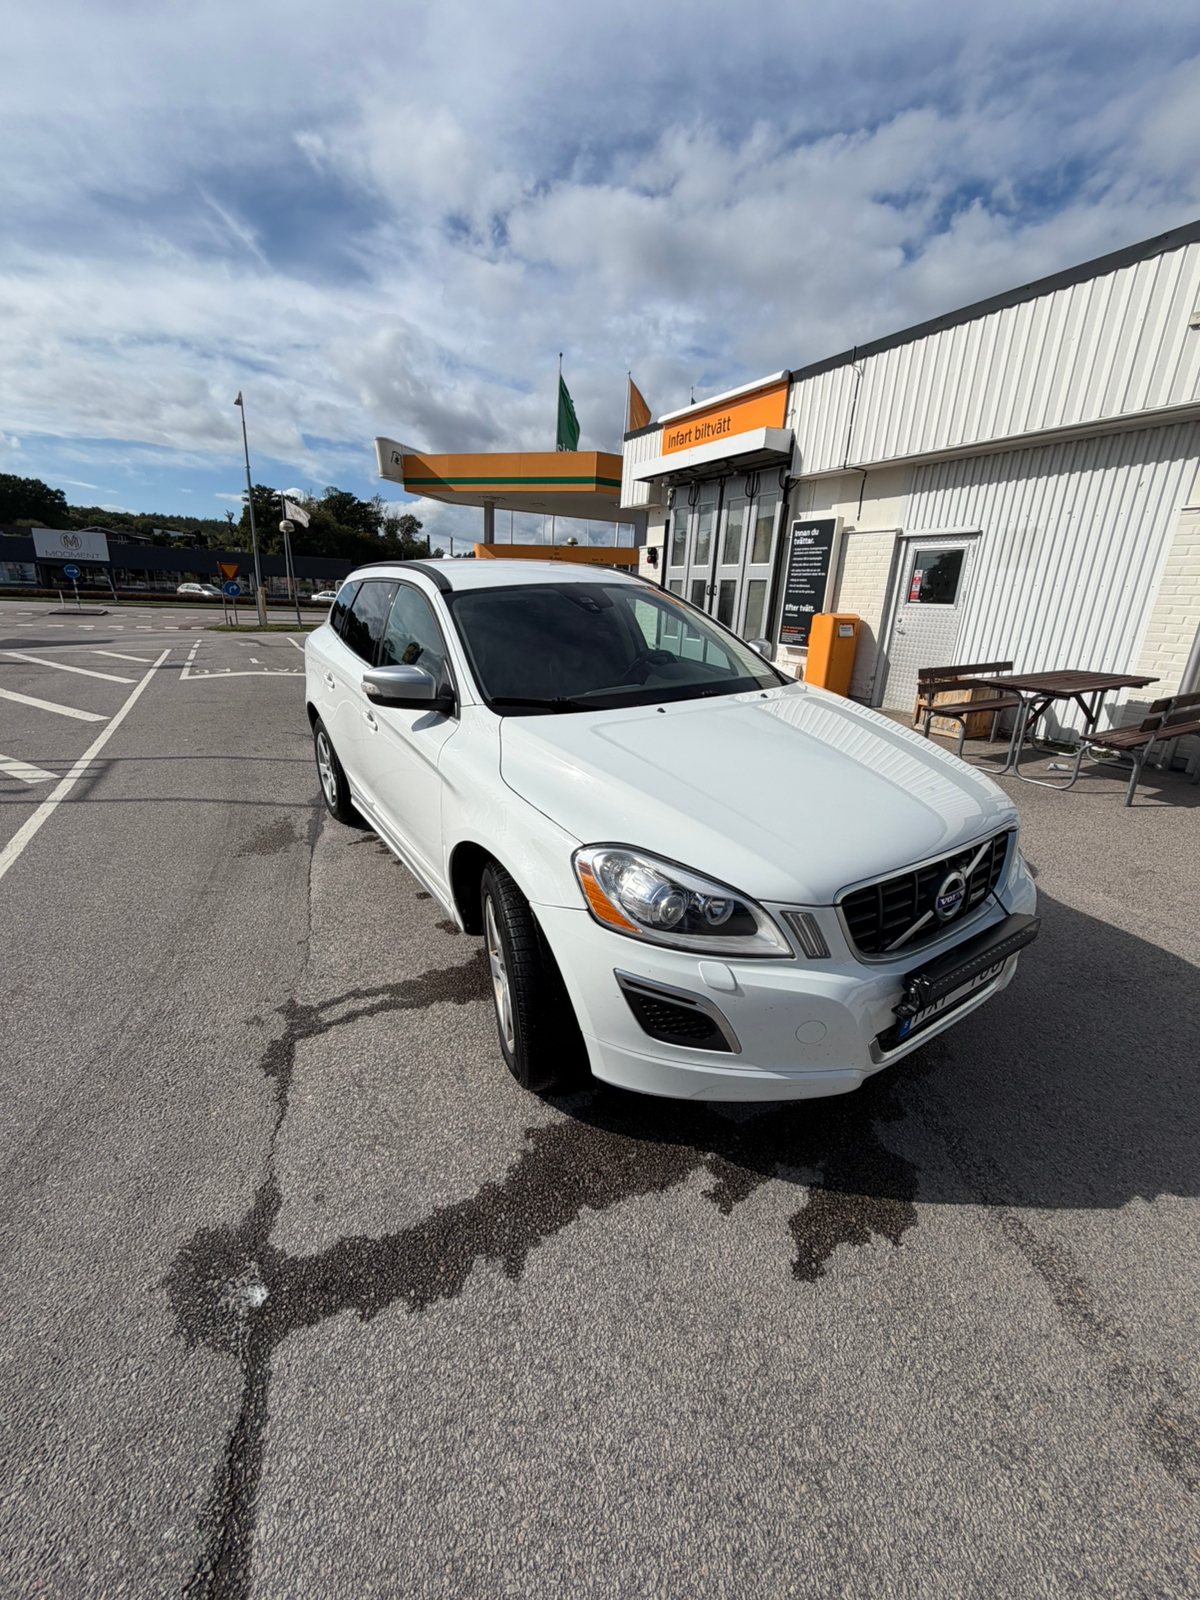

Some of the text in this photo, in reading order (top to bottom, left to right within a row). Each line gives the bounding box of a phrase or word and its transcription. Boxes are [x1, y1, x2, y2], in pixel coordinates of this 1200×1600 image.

[668, 416, 731, 448] Infart biltvätt
[811, 528, 819, 536] du
